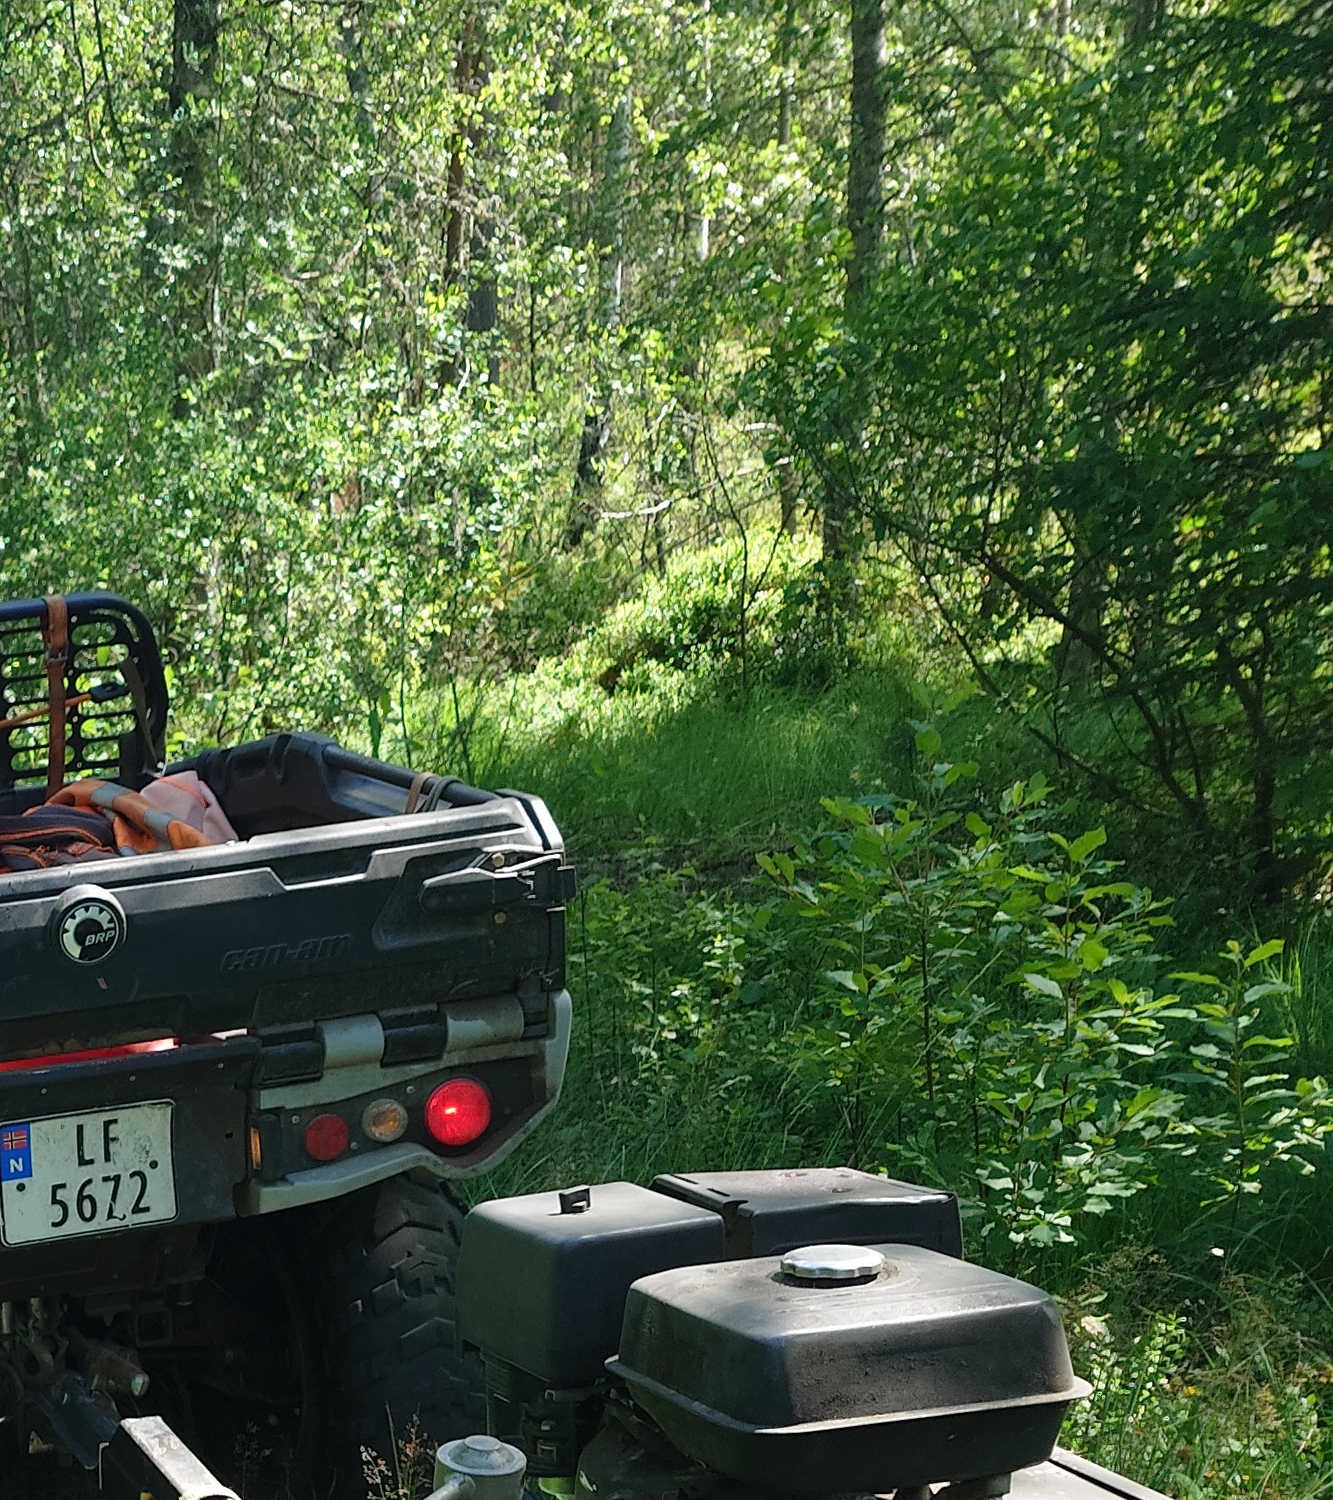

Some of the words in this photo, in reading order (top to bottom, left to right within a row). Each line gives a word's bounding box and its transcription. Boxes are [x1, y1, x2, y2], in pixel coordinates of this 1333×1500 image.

[85, 930, 115, 946] BRP
[76, 1118, 118, 1167] LF
[9, 1157, 24, 1173] N
[50, 1170, 151, 1228] 5672
